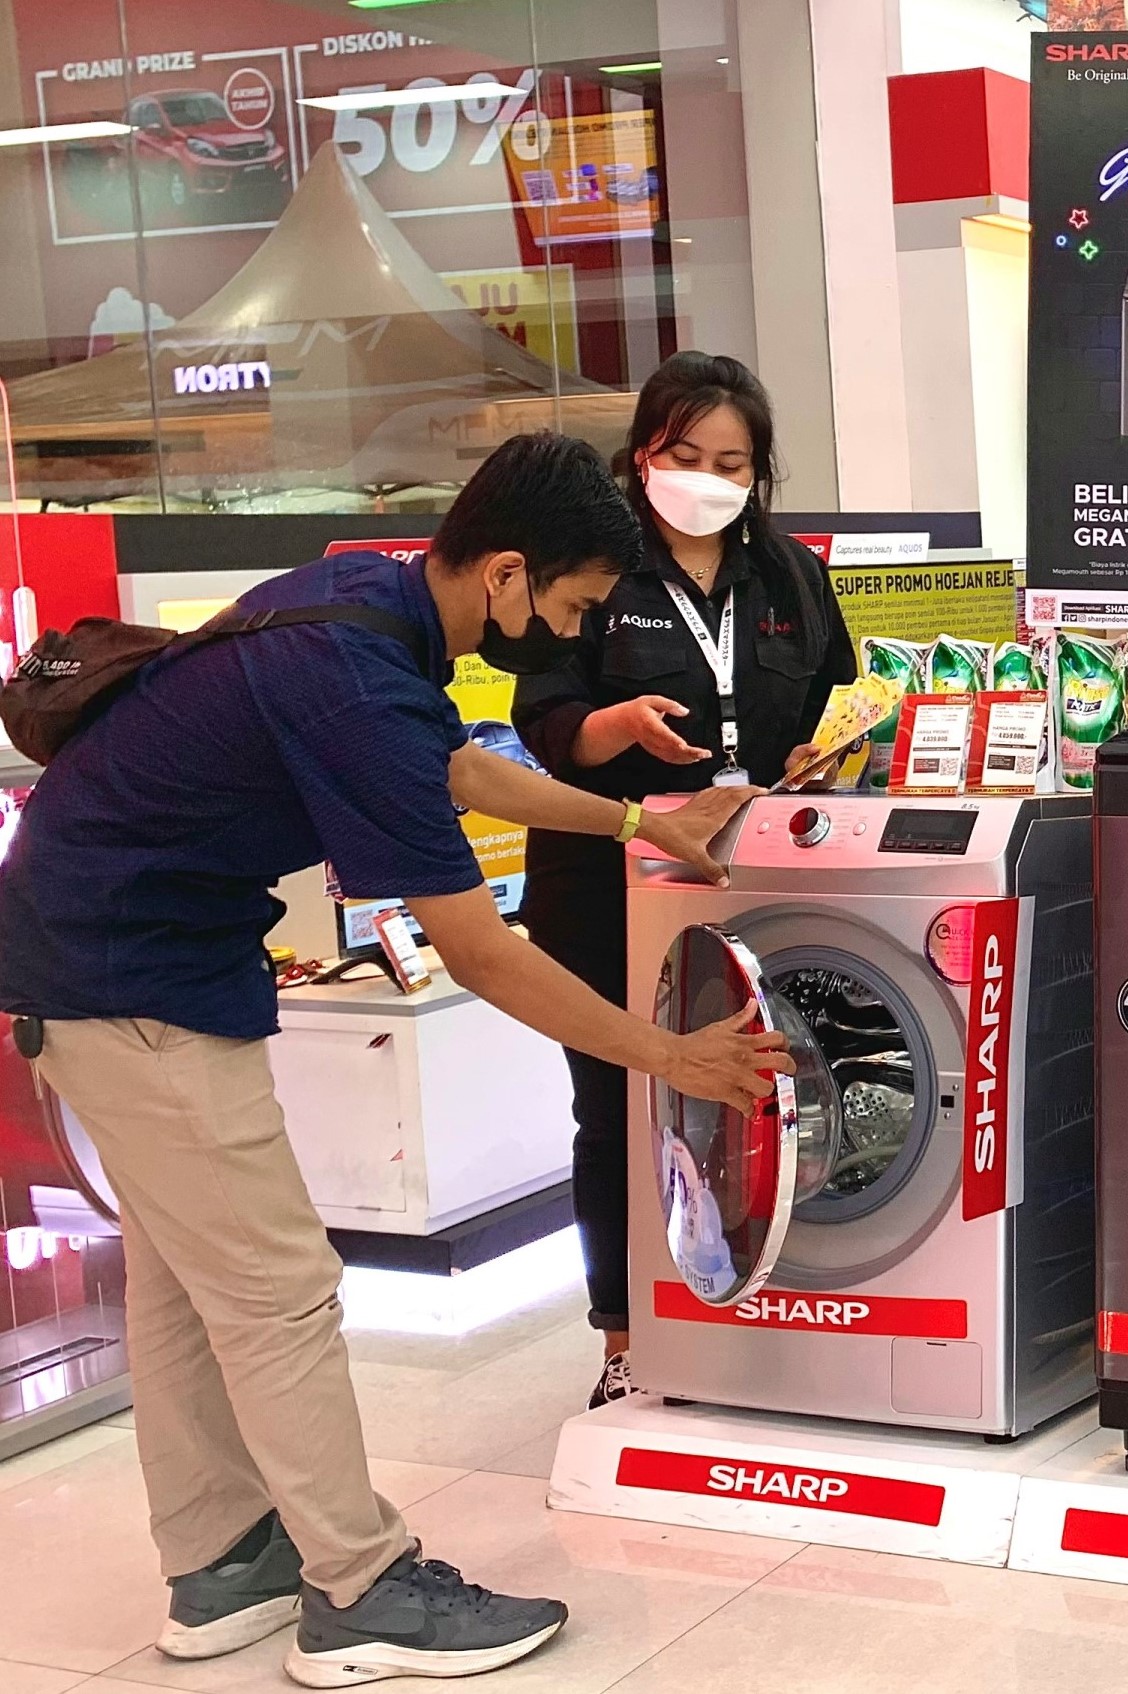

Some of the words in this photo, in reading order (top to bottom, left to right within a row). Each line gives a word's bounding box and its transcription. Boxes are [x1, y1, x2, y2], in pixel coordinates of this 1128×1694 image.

[323, 30, 403, 56] DISKON
[62, 57, 132, 82] GRAN
[136, 50, 196, 75] PRIZE
[1067, 69, 1082, 82] Be
[334, 69, 551, 177] 50%
[1074, 484, 1128, 505] BELI
[836, 544, 862, 555] Captures
[898, 544, 923, 554] AQUOS
[835, 575, 883, 597] SUPER
[886, 573, 932, 594] PROMO
[935, 571, 983, 591] HOEJAN
[985, 569, 1014, 588] REJE
[620, 613, 673, 630] AQUOS
[468, 829, 524, 850] lengkapnya
[974, 933, 1004, 1174] SHARP
[685, 1267, 716, 1294] SYSTEM
[735, 1296, 870, 1326] SHARP
[706, 1463, 849, 1503] SHARP
